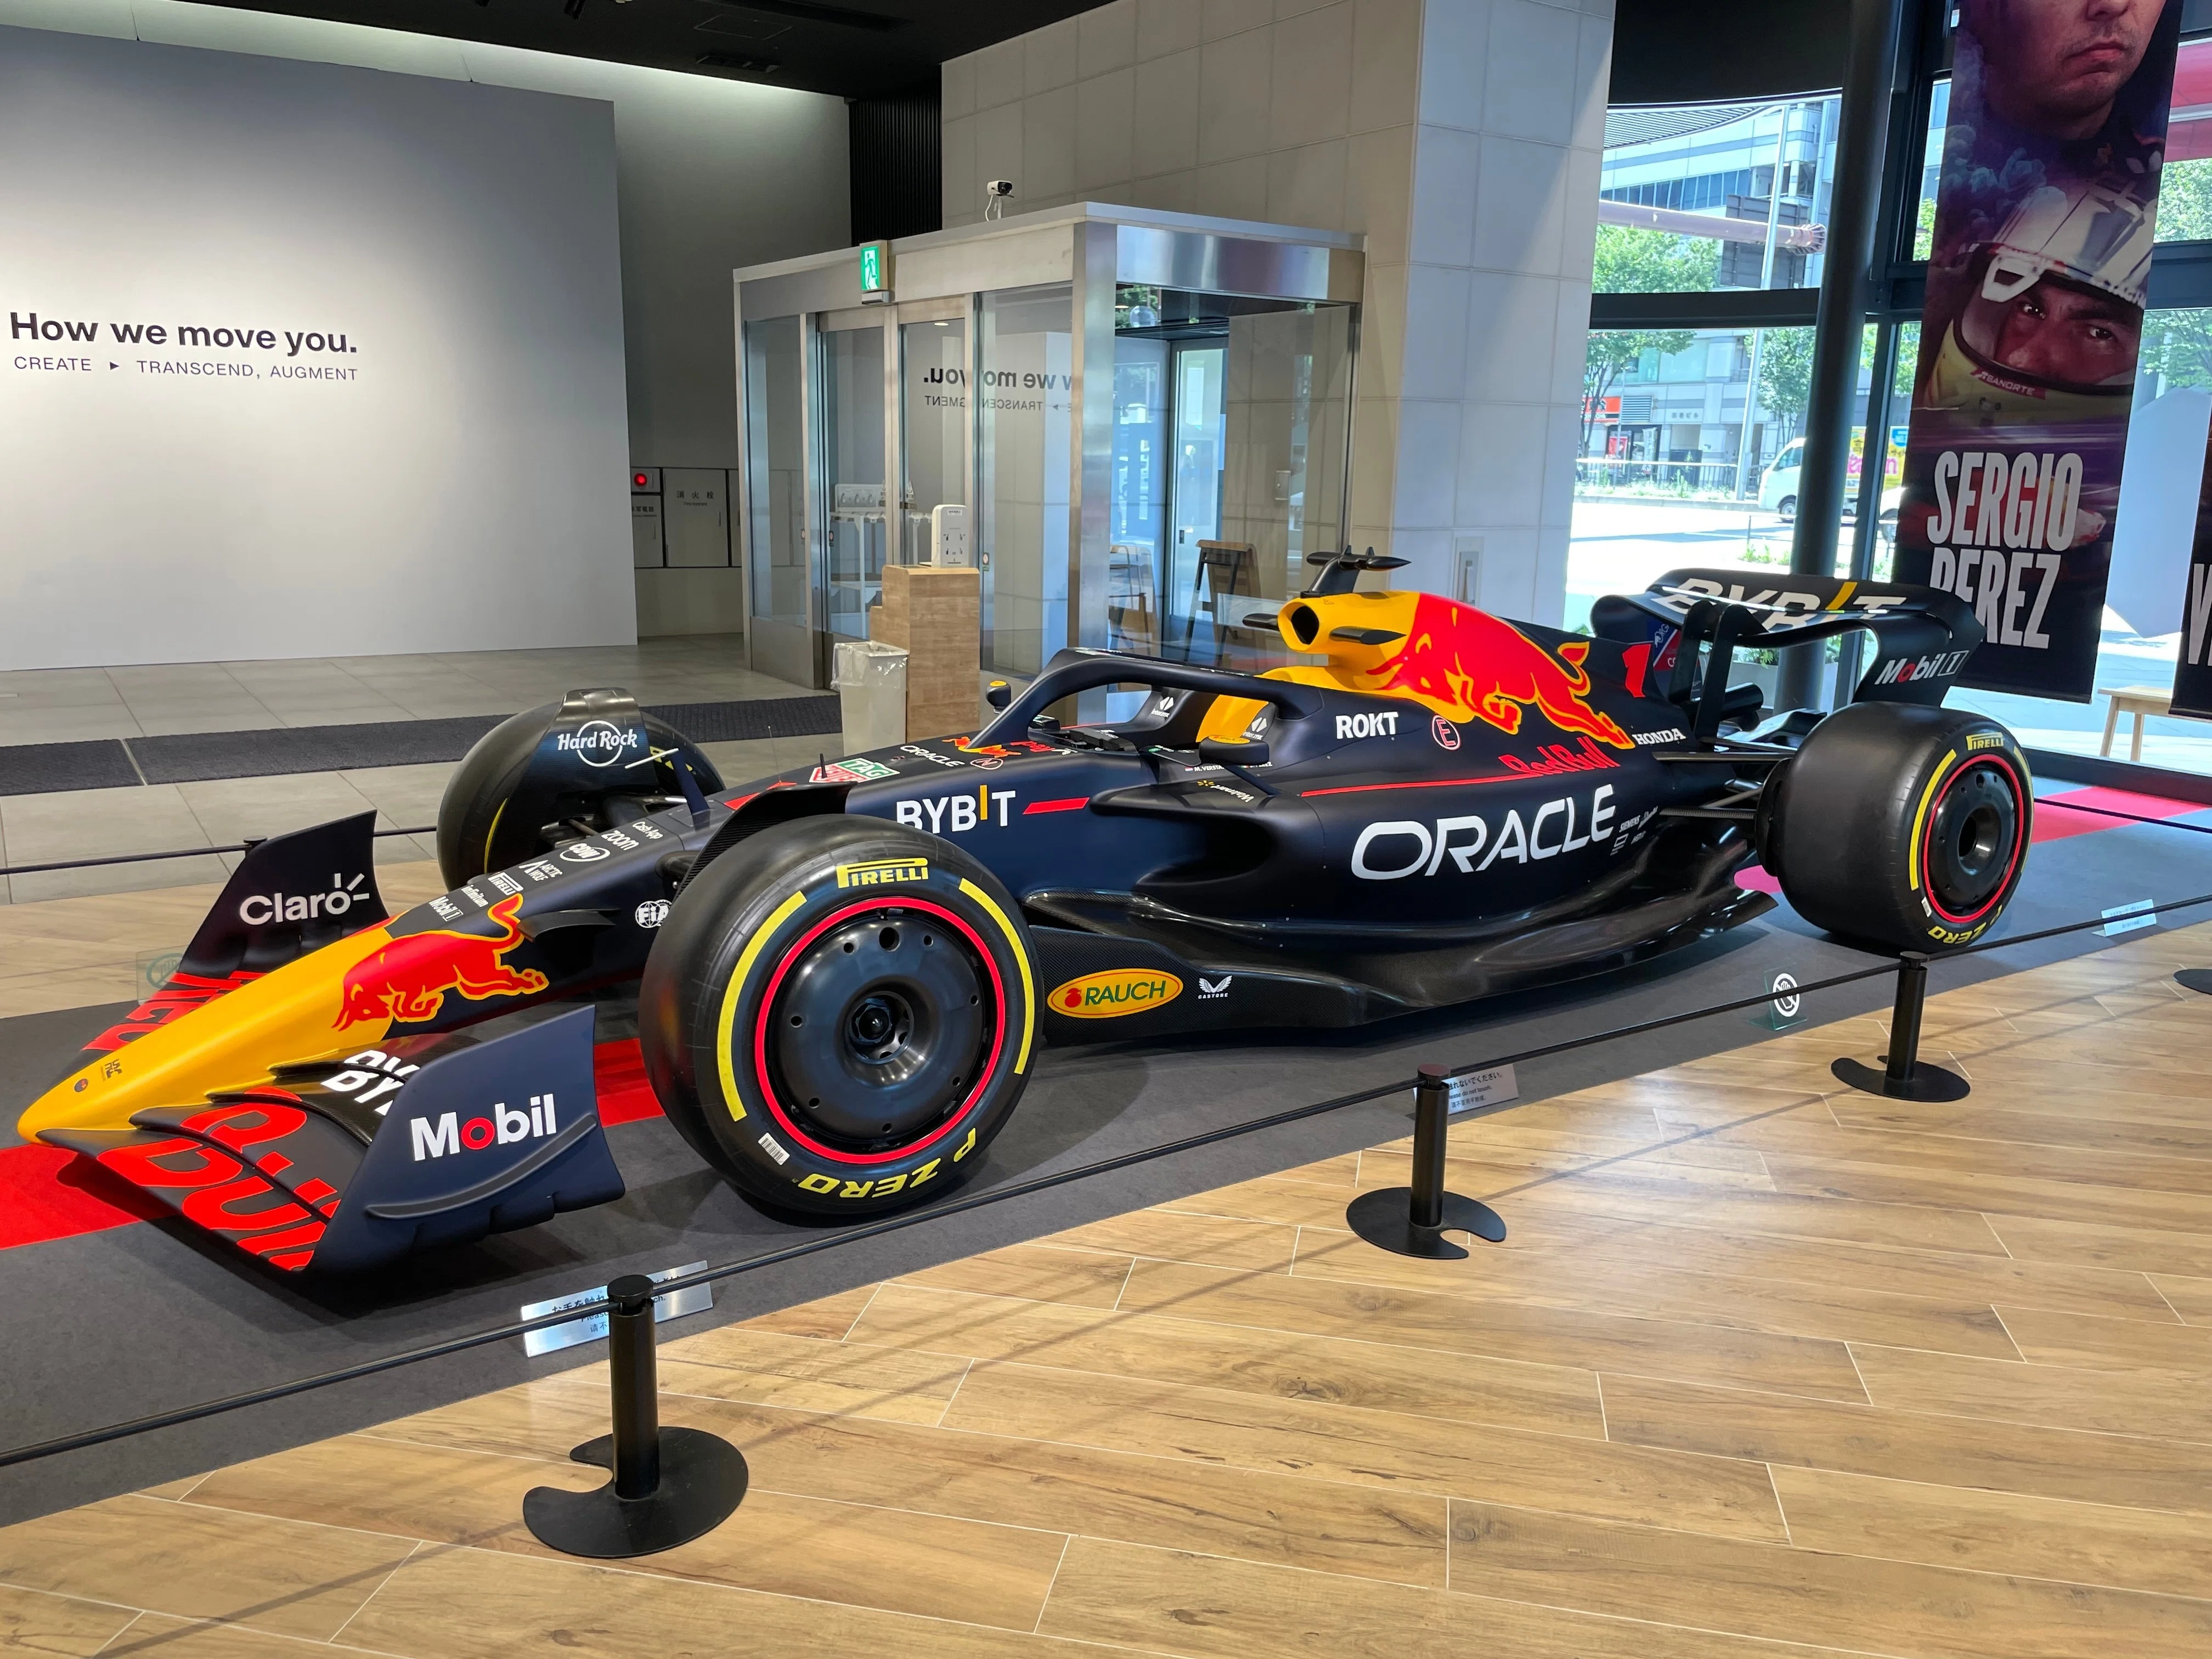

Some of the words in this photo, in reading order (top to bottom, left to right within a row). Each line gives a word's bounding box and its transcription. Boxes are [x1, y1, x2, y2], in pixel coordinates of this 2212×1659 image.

[10, 312, 99, 342] How
[110, 323, 167, 345] we
[178, 325, 276, 349] move
[284, 331, 358, 357] you.
[14, 356, 92, 371] CREATE
[136, 360, 261, 379] TRANSCEND,
[270, 366, 358, 381] AUGMENT
[1927, 451, 2084, 551] SERGIO
[1622, 644, 1651, 698] 1
[1874, 654, 1939, 685] Mobil
[1336, 712, 1398, 739] ROKT
[1632, 728, 1686, 746] HONDA
[557, 731, 597, 751] Hard
[599, 728, 638, 751] Rock
[1966, 732, 2004, 751] PIRELLI
[844, 760, 883, 778] TAG
[900, 745, 966, 768] ORACLE
[896, 785, 1016, 834] BYBIT
[632, 821, 652, 832] Cash
[646, 827, 663, 839] App
[1351, 783, 1616, 879] ORACLE
[568, 843, 600, 859] CDW
[488, 872, 524, 895] PIRELLI
[837, 857, 929, 888] PIRELLI
[239, 892, 351, 926] Claro
[428, 896, 458, 916] Mobil
[1085, 980, 1166, 1006] RAUCH
[410, 1094, 557, 1161] Mobil
[953, 1127, 976, 1163] P
[798, 1158, 941, 1198] ZERO
